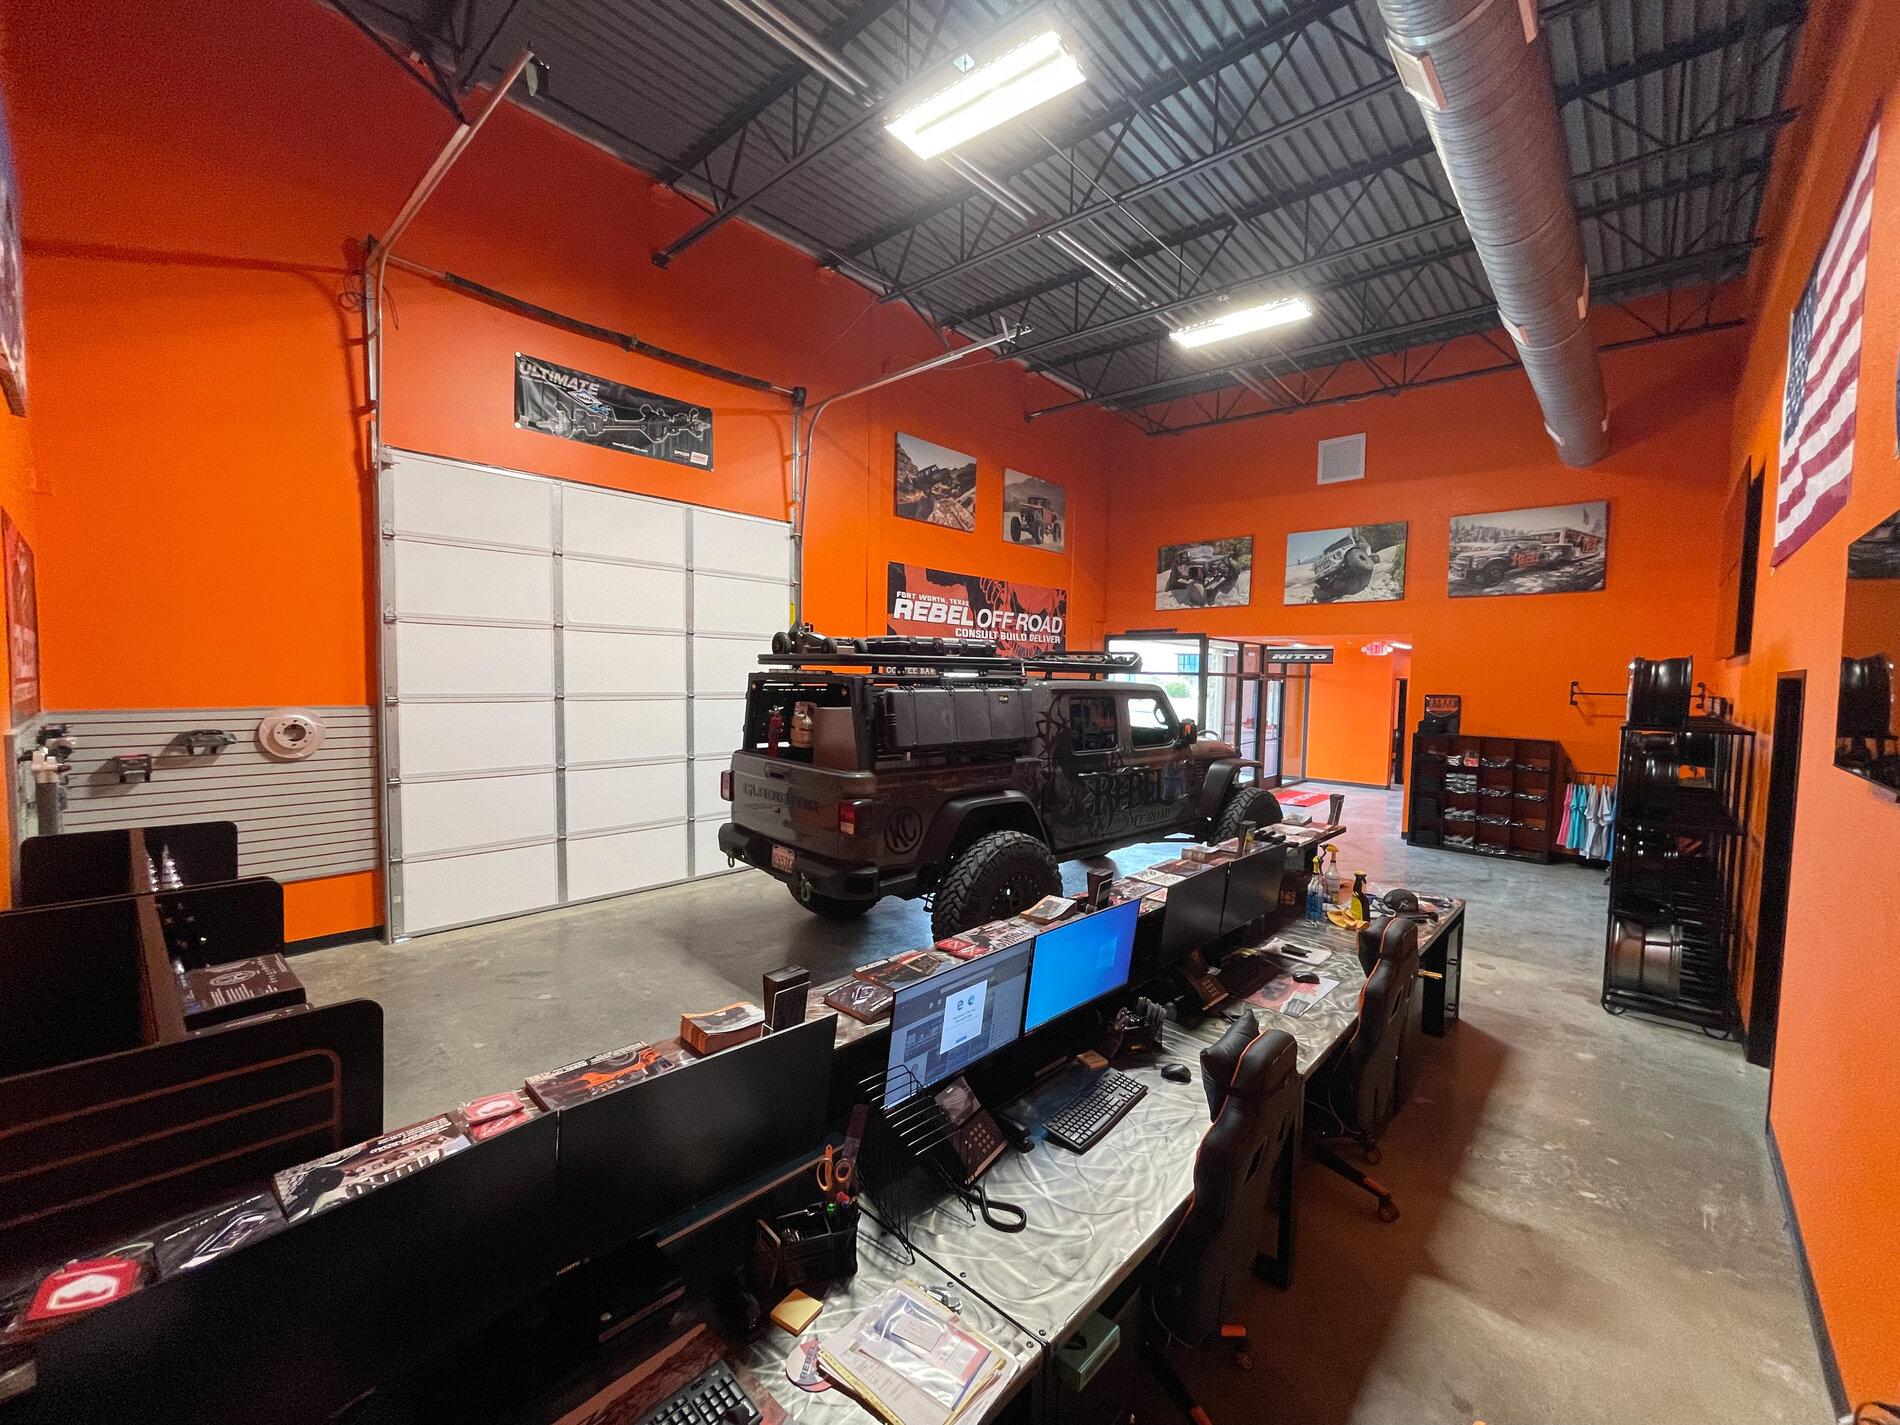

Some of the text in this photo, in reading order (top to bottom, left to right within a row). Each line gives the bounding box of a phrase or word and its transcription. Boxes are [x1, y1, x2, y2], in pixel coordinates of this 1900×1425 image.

[520, 361, 600, 396] ULTIMATE
[896, 591, 969, 606] FORT WORTH, TEXAS
[893, 598, 1063, 634] REBEL OFF ROAD
[955, 628, 1061, 644] CONSULT BUILD DELIVER
[885, 666, 918, 674] COEE
[889, 812, 917, 849] KC
